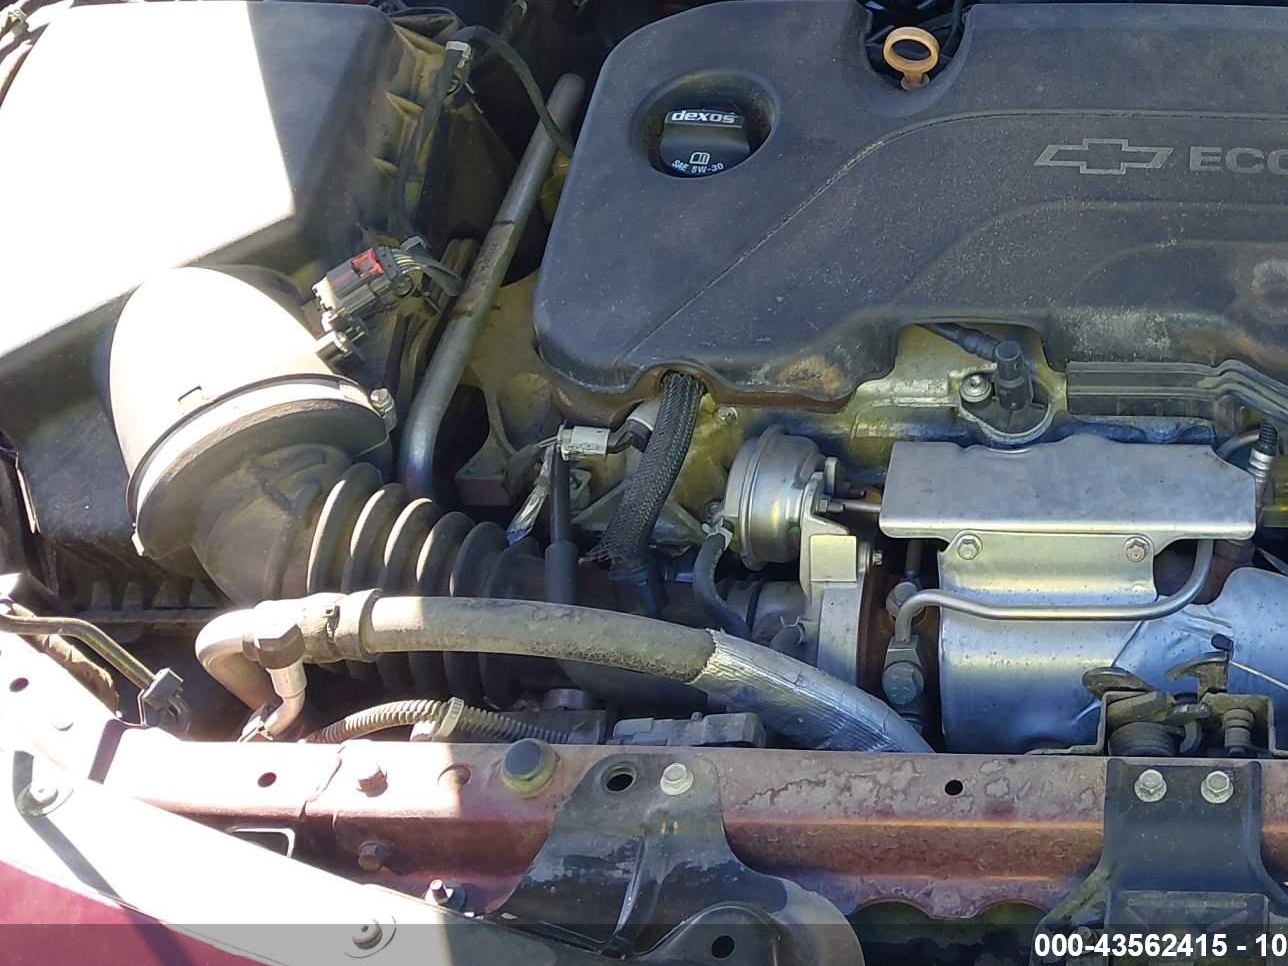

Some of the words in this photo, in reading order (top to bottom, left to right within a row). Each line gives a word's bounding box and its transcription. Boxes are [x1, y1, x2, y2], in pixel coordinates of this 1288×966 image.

[671, 109, 737, 124] dexos
[671, 158, 690, 173] SAE
[691, 161, 725, 174] 5W-30
